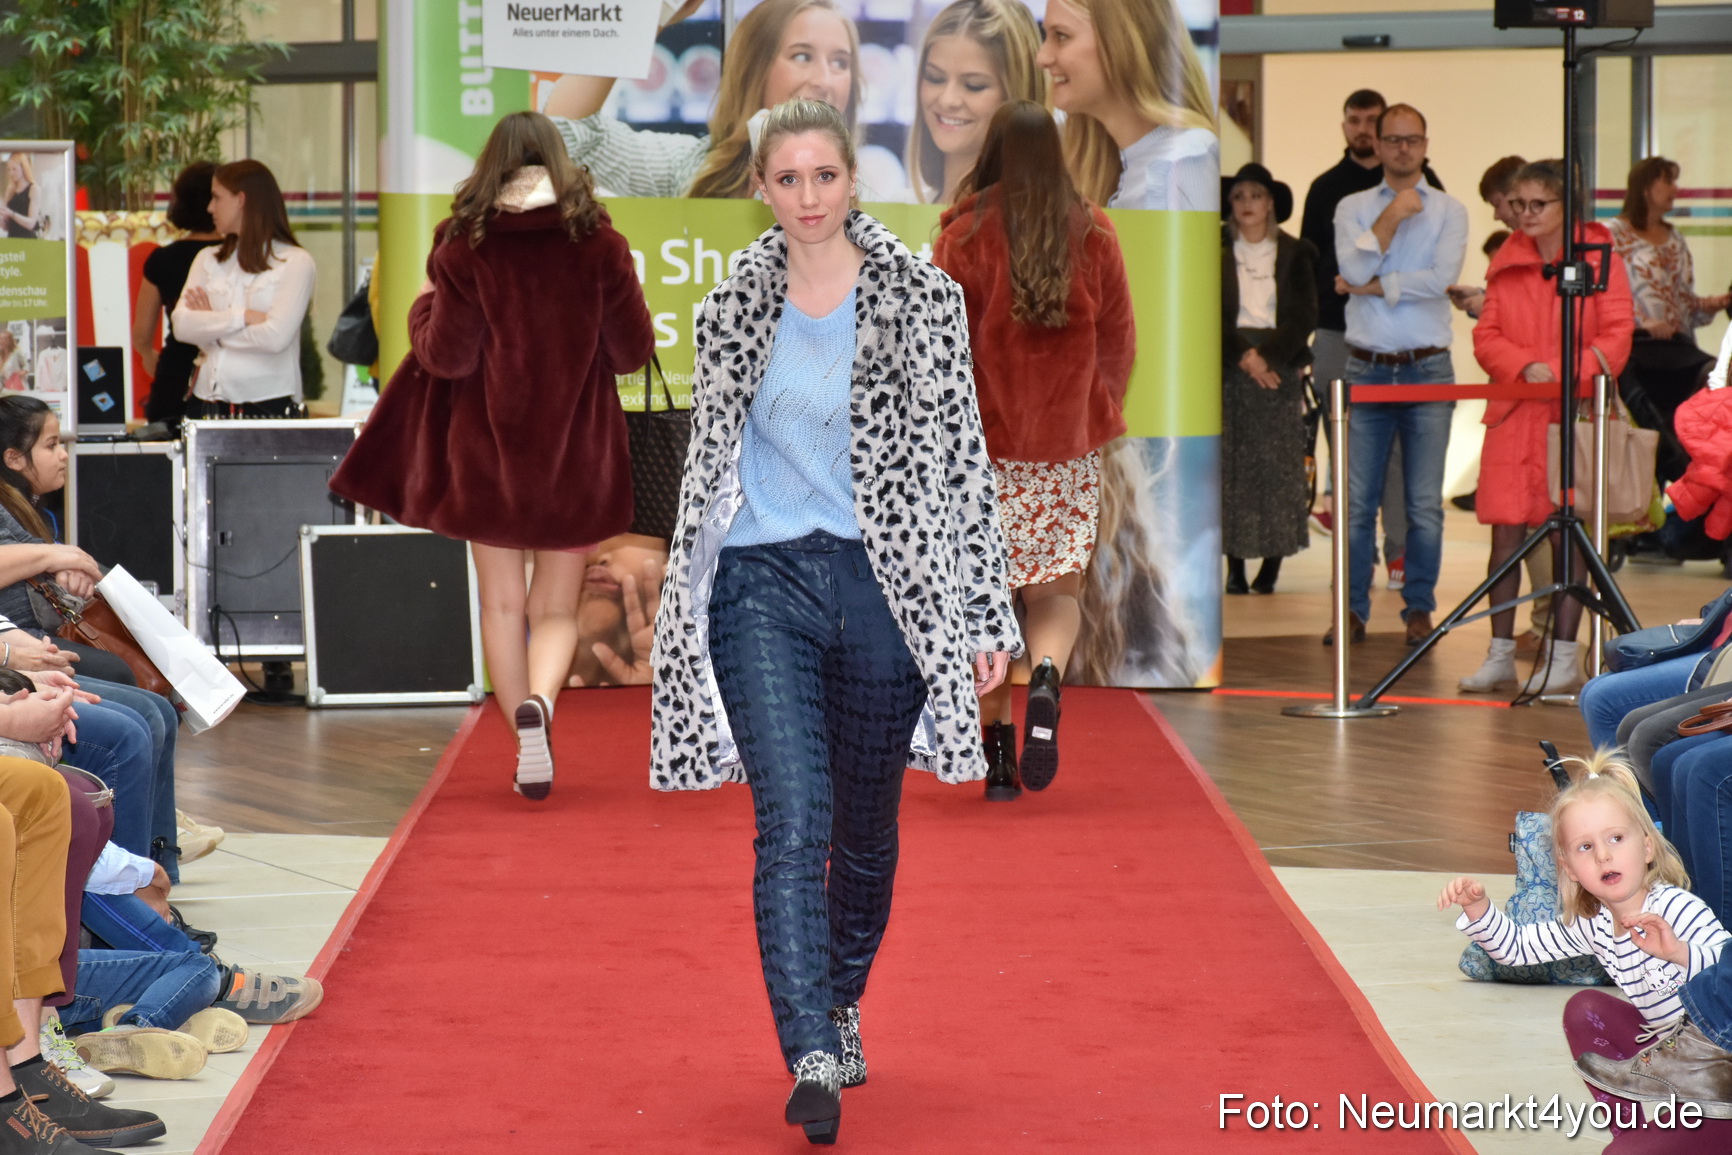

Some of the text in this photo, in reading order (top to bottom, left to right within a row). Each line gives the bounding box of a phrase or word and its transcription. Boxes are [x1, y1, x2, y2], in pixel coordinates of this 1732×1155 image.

[507, 3, 622, 21] NeuerMarkt
[513, 28, 620, 37] Alles unter einem Dach.
[24, 298, 32, 307] 17
